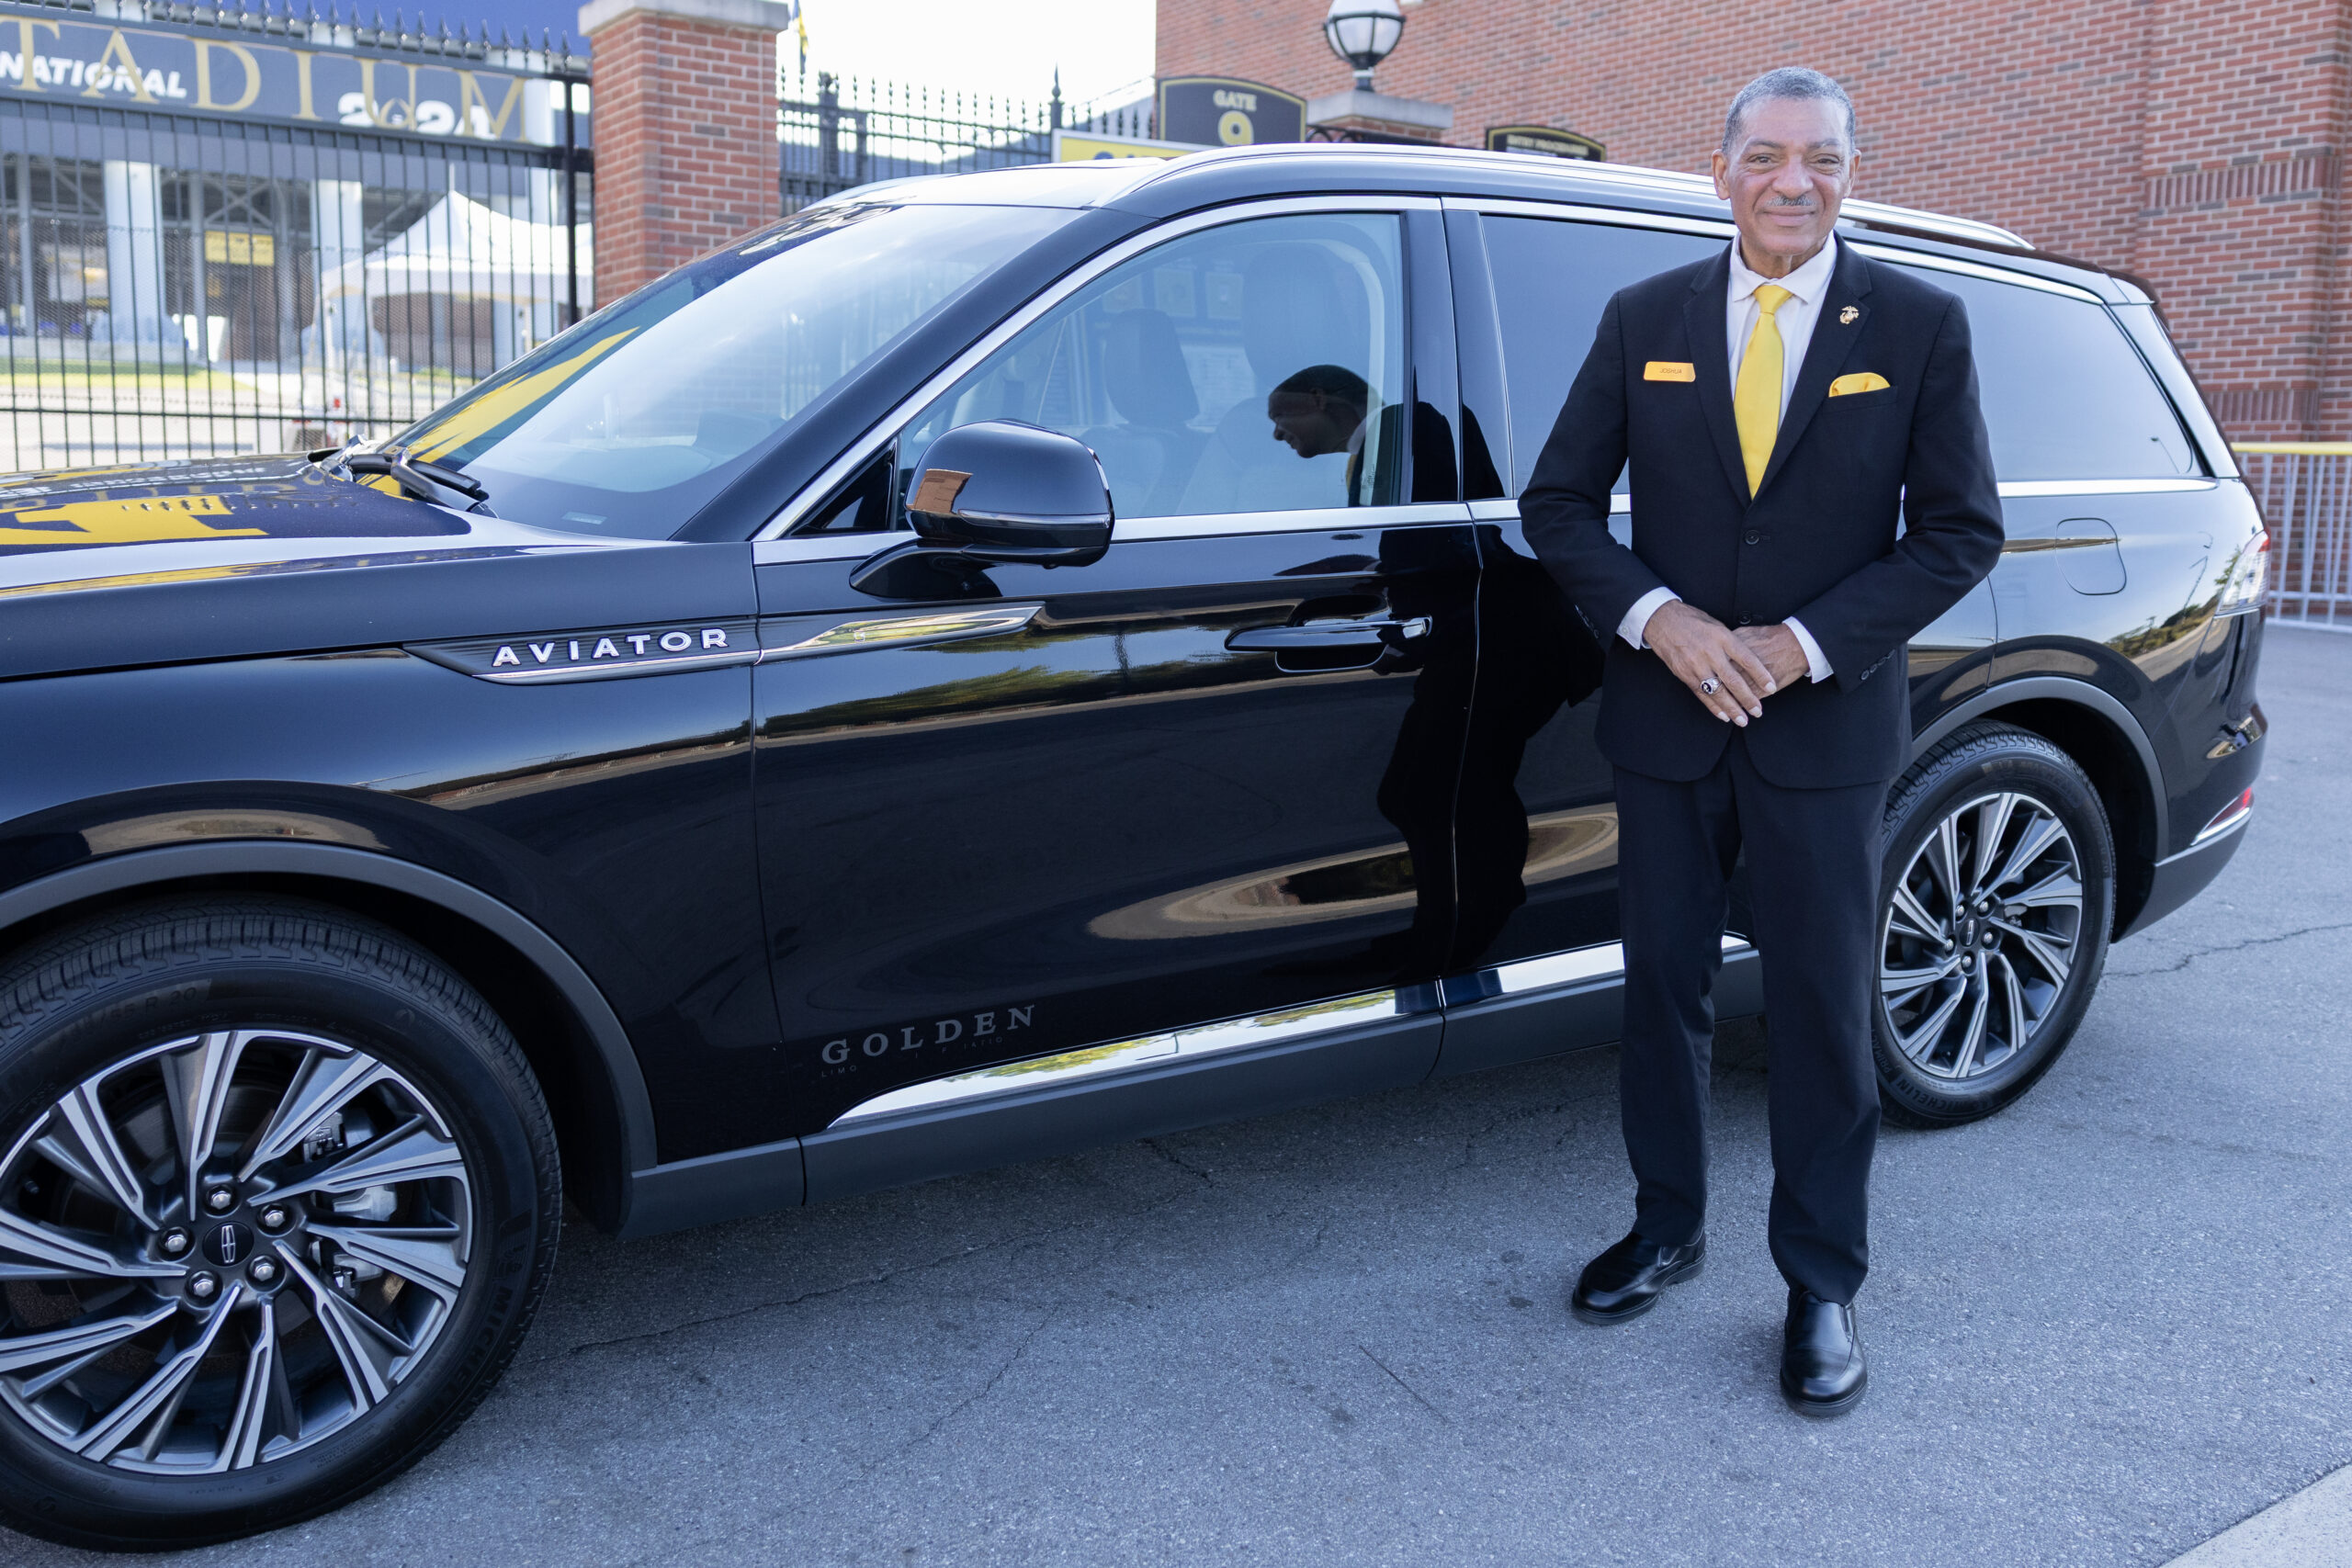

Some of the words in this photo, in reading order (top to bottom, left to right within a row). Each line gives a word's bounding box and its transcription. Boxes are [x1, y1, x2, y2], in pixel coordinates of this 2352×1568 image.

[1213, 89, 1257, 111] GATE
[492, 627, 729, 667] AVIATOR
[821, 1004, 1035, 1065] GOLDEN
